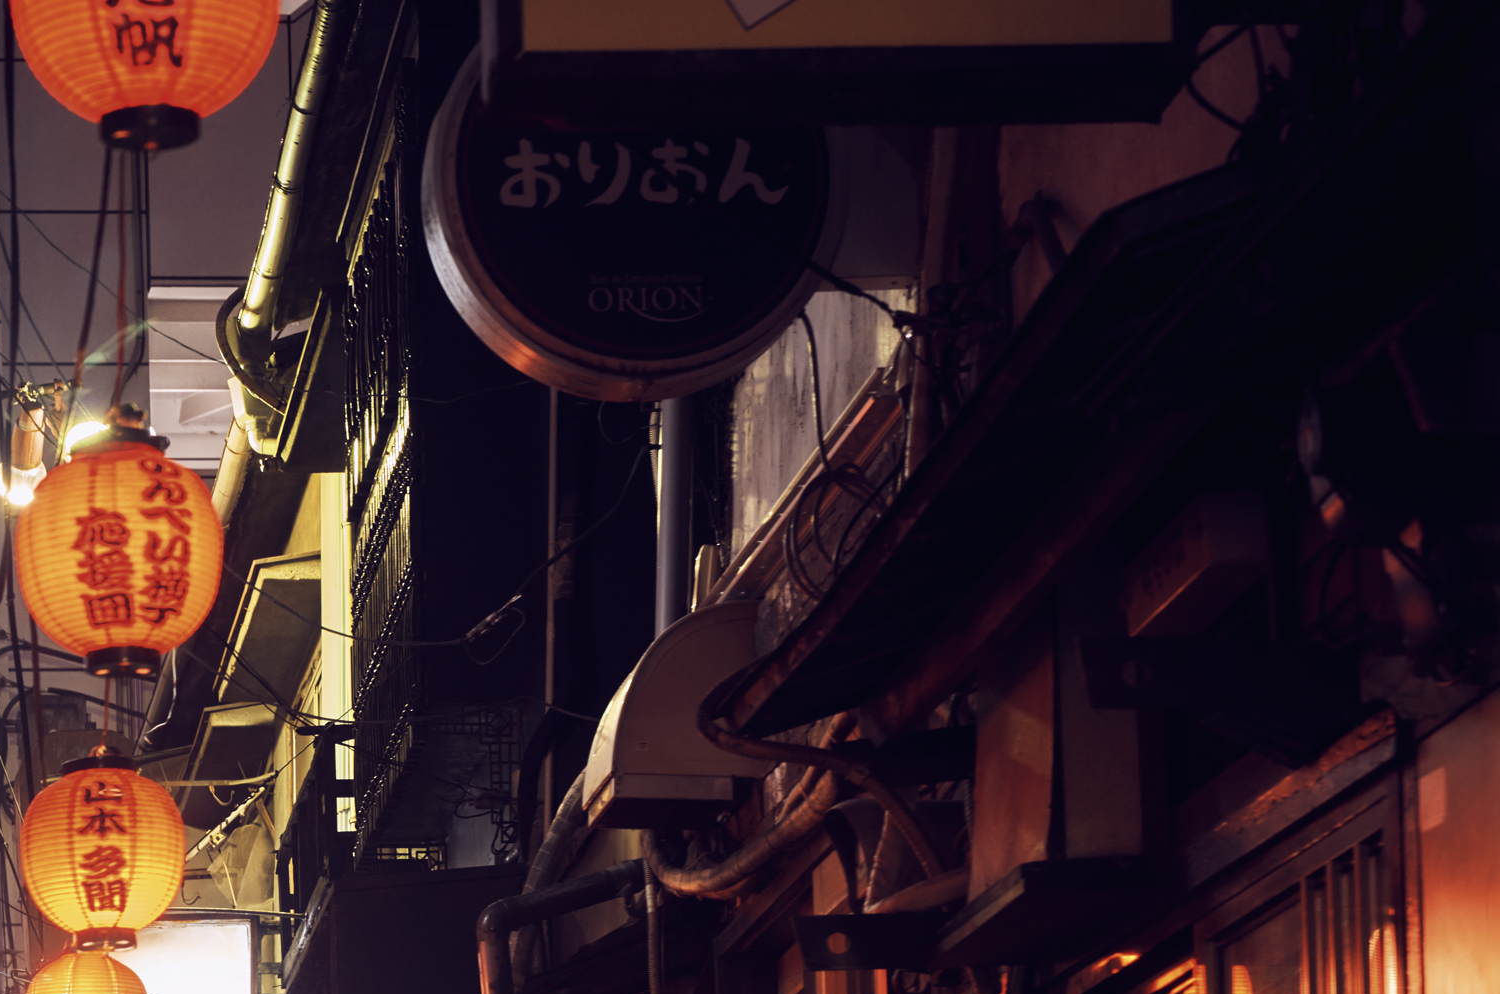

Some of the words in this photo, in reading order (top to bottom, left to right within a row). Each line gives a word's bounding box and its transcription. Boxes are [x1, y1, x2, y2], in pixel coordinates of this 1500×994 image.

[104, 0, 183, 67] 帆
[499, 136, 789, 208] おりおん
[588, 285, 704, 316] ORION
[77, 781, 128, 912] 山本多聞
